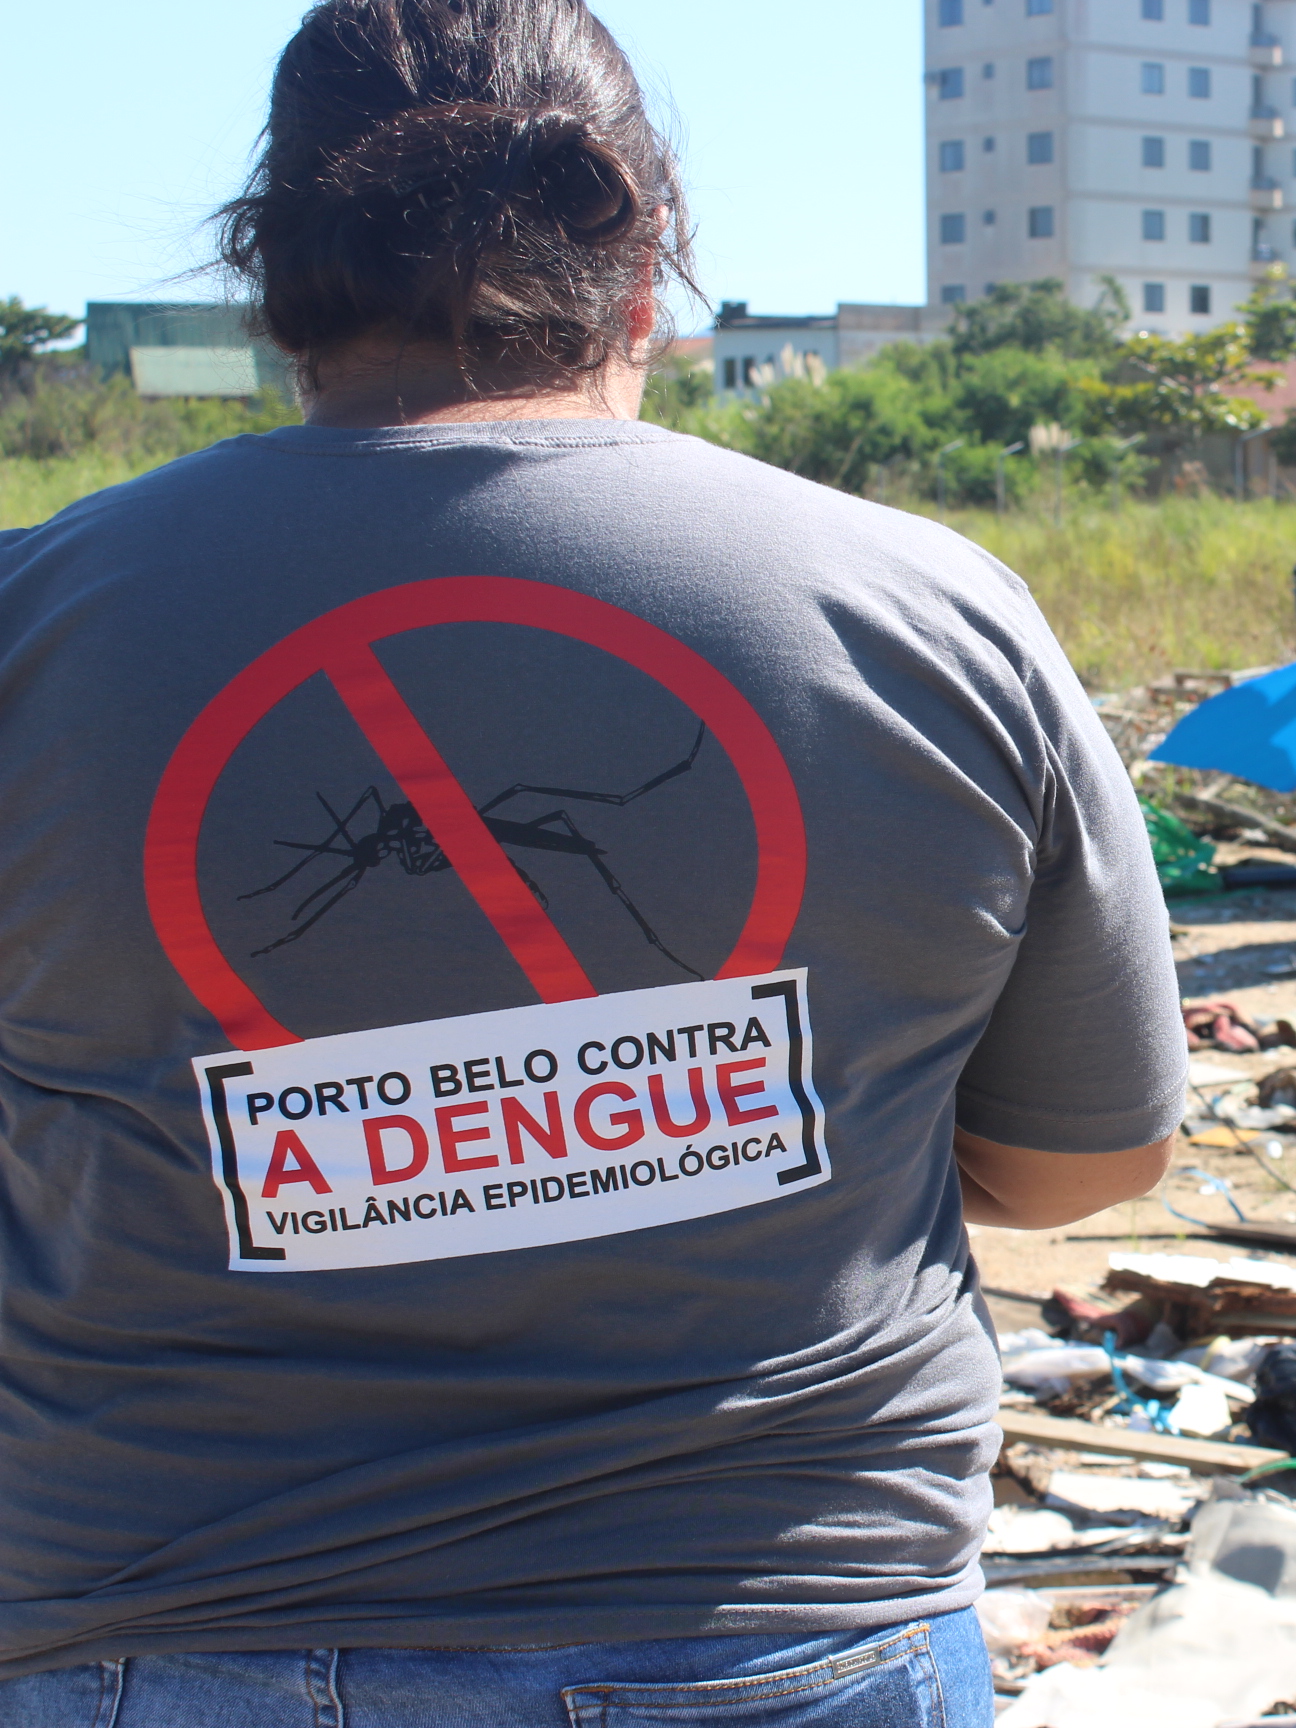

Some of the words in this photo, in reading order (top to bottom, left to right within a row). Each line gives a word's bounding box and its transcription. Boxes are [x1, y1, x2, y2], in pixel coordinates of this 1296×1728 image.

[246, 1071, 412, 1126] PORTO
[429, 1048, 559, 1099] BELO
[577, 1016, 772, 1076] CONTRA
[261, 1129, 333, 1199] A
[361, 1056, 780, 1187] DENGUE
[265, 1188, 476, 1236] VIGILÂNCIA
[482, 1132, 788, 1211] EPIDEMIOLÓGICA
